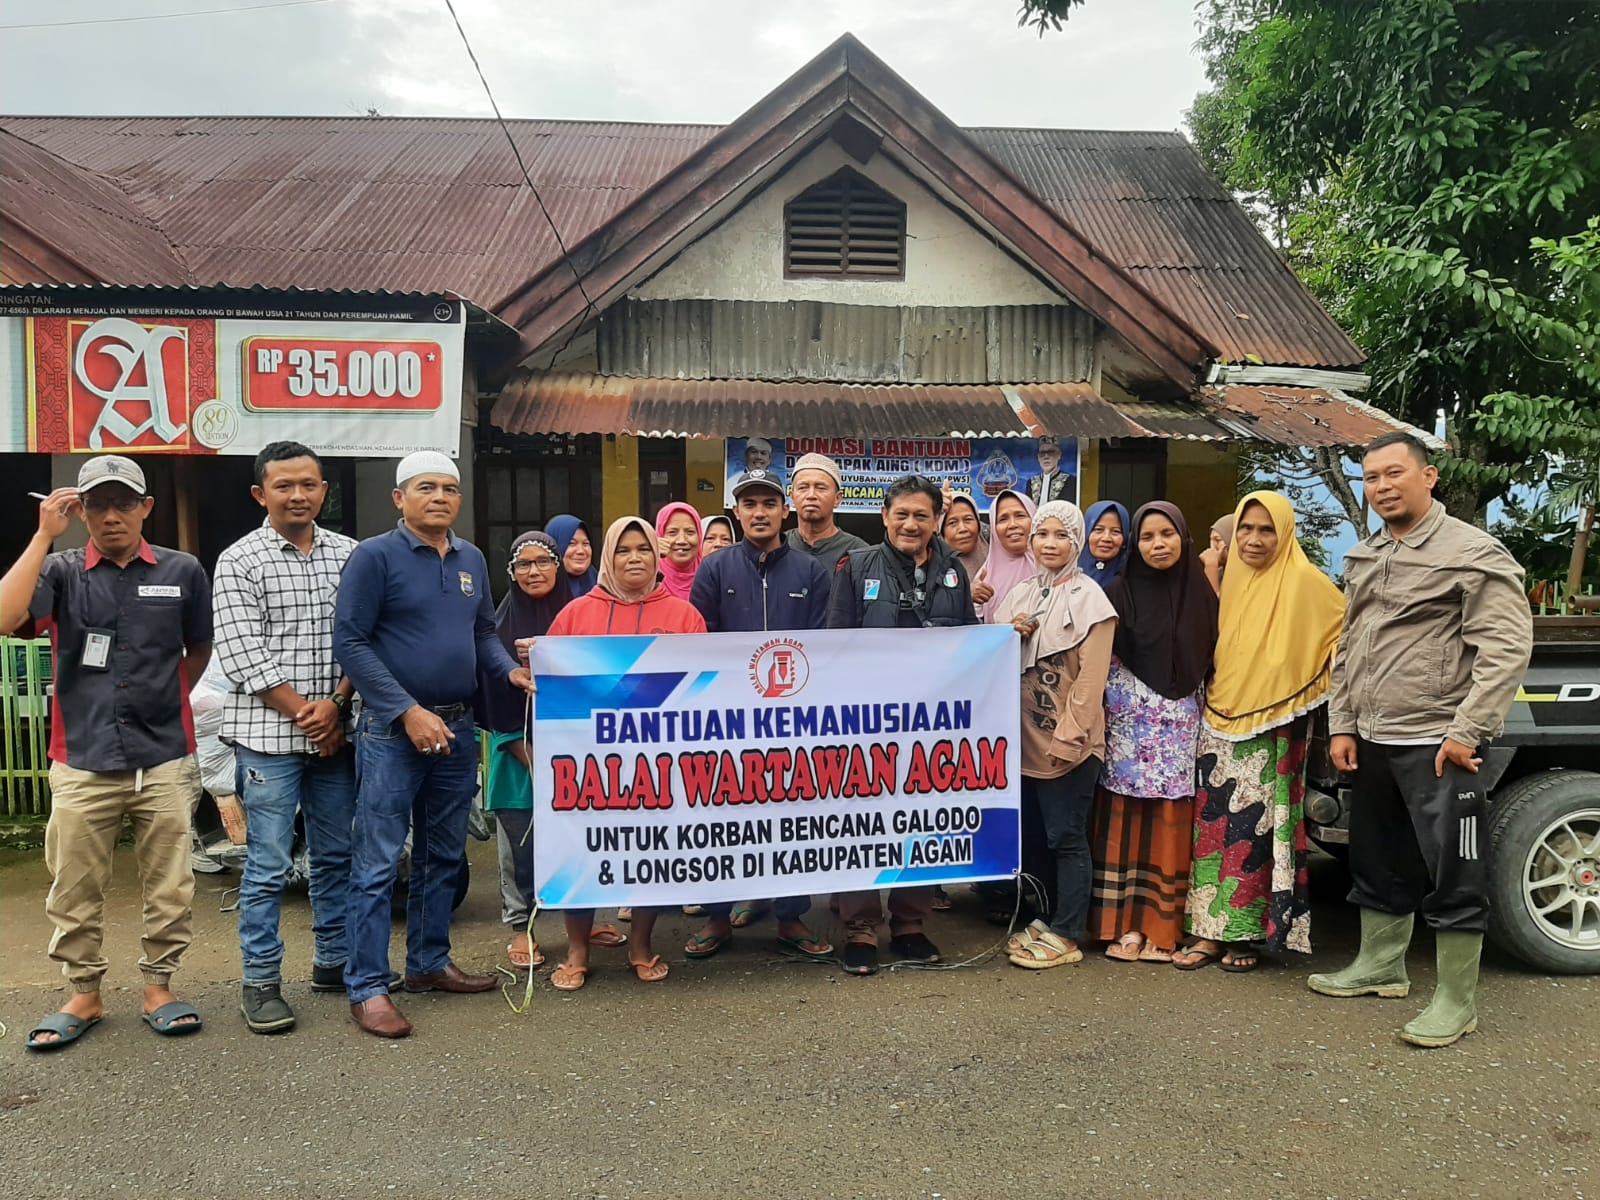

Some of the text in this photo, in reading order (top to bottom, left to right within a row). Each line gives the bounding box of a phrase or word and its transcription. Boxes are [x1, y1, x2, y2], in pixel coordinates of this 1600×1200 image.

[73, 307, 108, 315] MENJUAL
[197, 308, 225, 316] ORANG
[236, 309, 264, 317] BAWAH
[265, 309, 283, 317] USIA
[285, 310, 293, 318] 21
[295, 310, 321, 318] TAHUN
[323, 311, 339, 319] DAN
[341, 312, 388, 320] PEREMPUAN
[390, 312, 414, 320] HAMIL
[436, 309, 450, 317] 21+
[257, 349, 284, 373] RP
[785, 436, 972, 457] DONASI BANTUAN
[834, 457, 872, 472] APAK
[876, 459, 909, 472] AING
[924, 459, 958, 473] KDM
[748, 637, 781, 670] WARTAWAN
[783, 637, 805, 650] AGAM
[595, 700, 972, 744] BANTUAN KEMANUSIAAN
[551, 736, 1008, 811] BALAI WARTAWAN AGAM
[586, 806, 981, 852] UNTUK KORBAN BENCANA GALODO
[598, 838, 972, 885] & LONGSOR DI KABUPATEN AGAM
